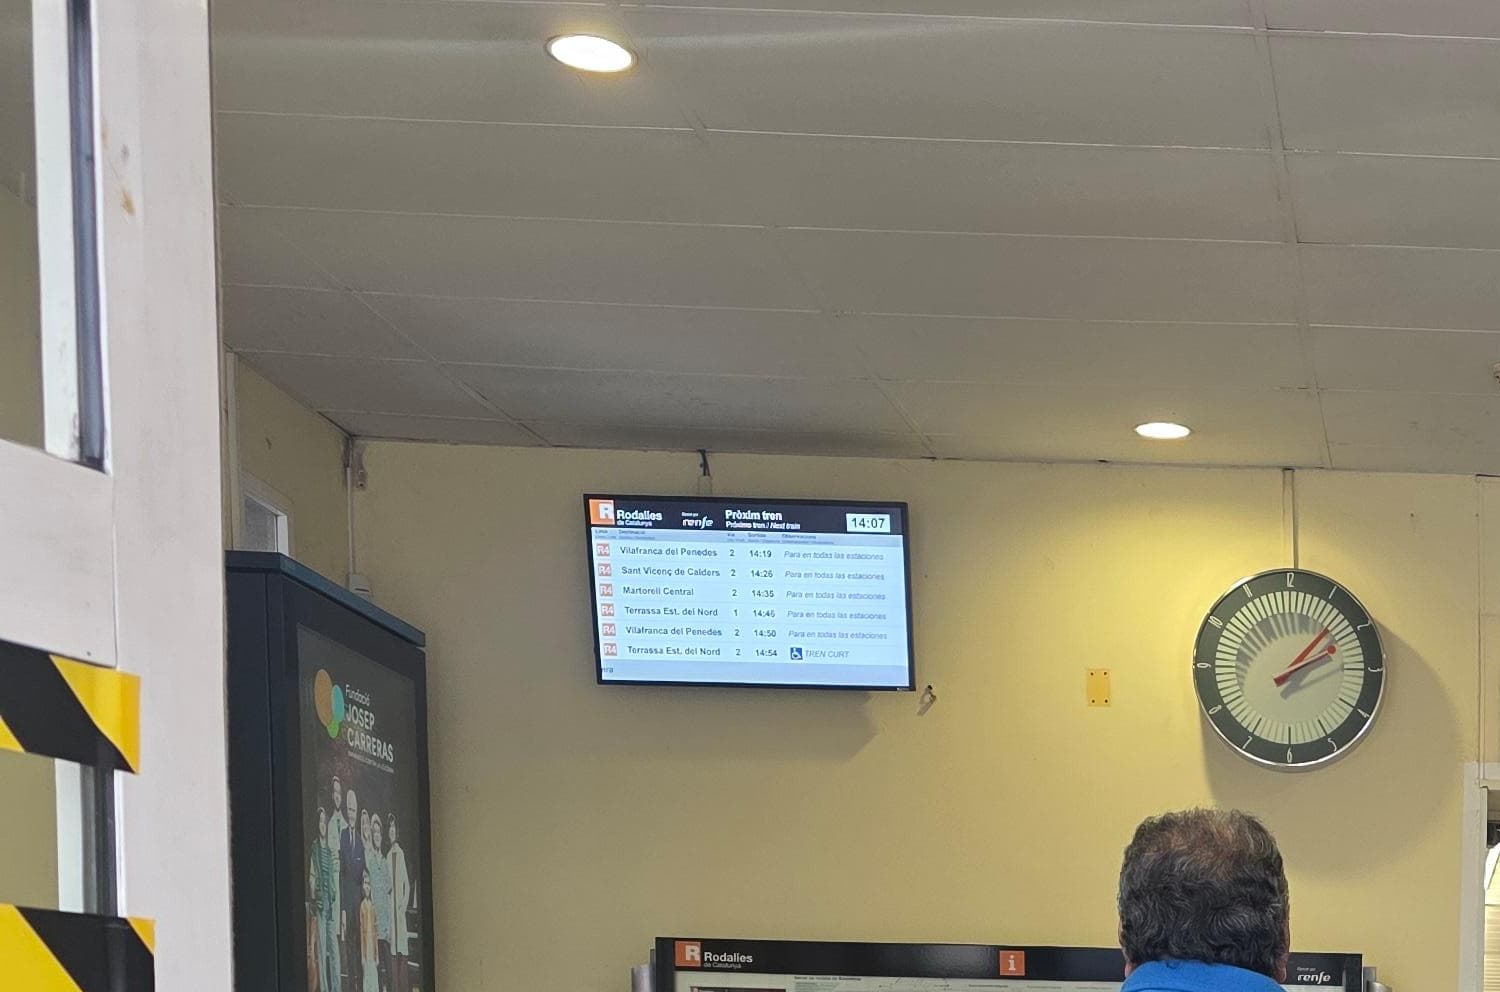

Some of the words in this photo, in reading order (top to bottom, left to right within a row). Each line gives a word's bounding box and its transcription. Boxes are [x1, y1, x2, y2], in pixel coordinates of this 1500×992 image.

[616, 510, 662, 520] Rodalies
[724, 509, 760, 520] Pròxim
[762, 510, 782, 521] tren
[682, 516, 714, 529] renfe
[851, 518, 885, 529] 14:07
[620, 546, 663, 555] Vilafranca
[666, 547, 678, 555] del
[622, 567, 641, 575] Sant
[643, 568, 672, 576] Vicenç
[623, 586, 661, 595] Martorell
[663, 587, 694, 596] Central
[625, 606, 661, 615] Terrassa
[664, 607, 679, 616] Est.
[682, 607, 695, 616] del
[698, 608, 718, 616] Nord
[626, 627, 668, 635] Vilafranca
[671, 627, 683, 635] del
[628, 646, 664, 654] Terrassa
[666, 647, 682, 655] Est.
[685, 647, 697, 655] del
[346, 704, 375, 731] JOSEP
[348, 728, 394, 762] CARRERAS
[685, 945, 700, 961] R
[704, 952, 753, 963] Rodalies
[1297, 971, 1331, 985] renfe
